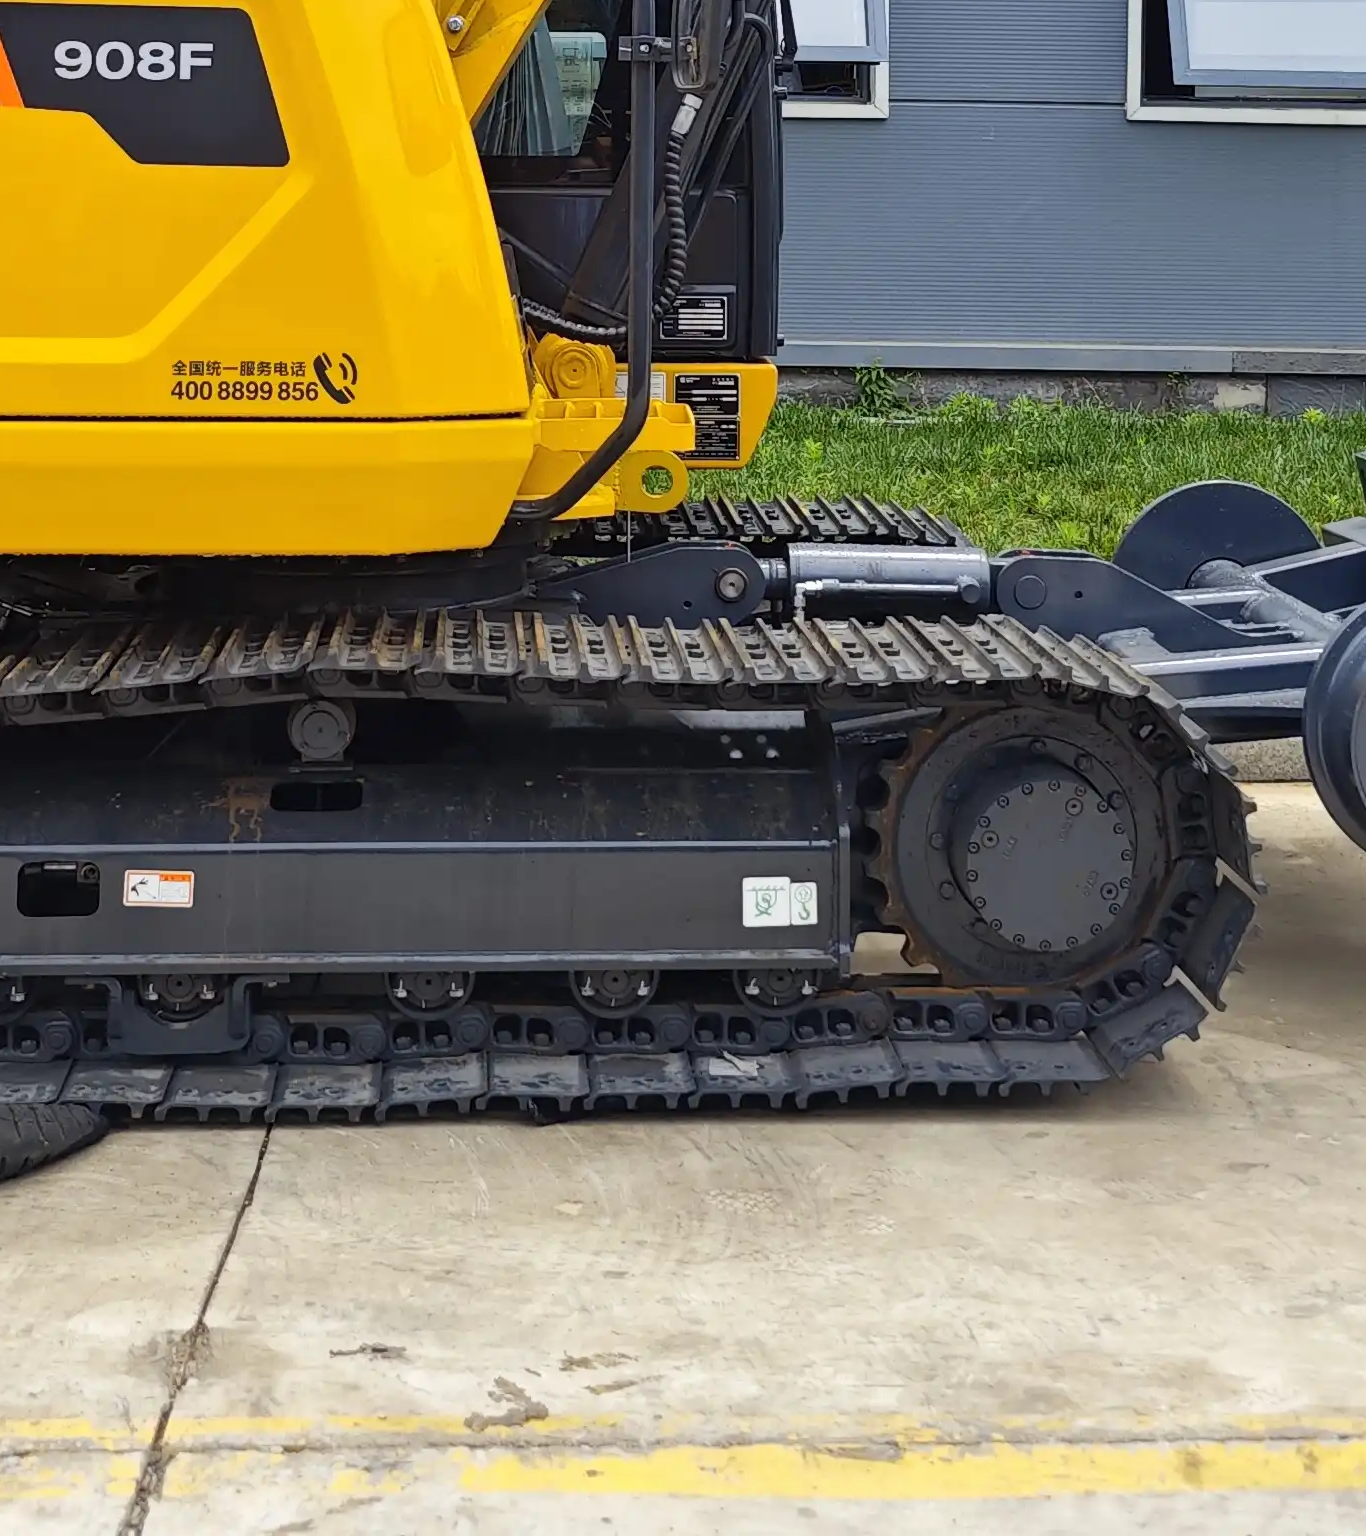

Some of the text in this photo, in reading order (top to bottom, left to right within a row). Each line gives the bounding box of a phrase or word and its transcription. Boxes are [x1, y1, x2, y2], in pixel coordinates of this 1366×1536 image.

[54, 40, 214, 81] 908F
[171, 359, 307, 378] 全国统一服务电话
[171, 380, 320, 402] 400 8899 856
